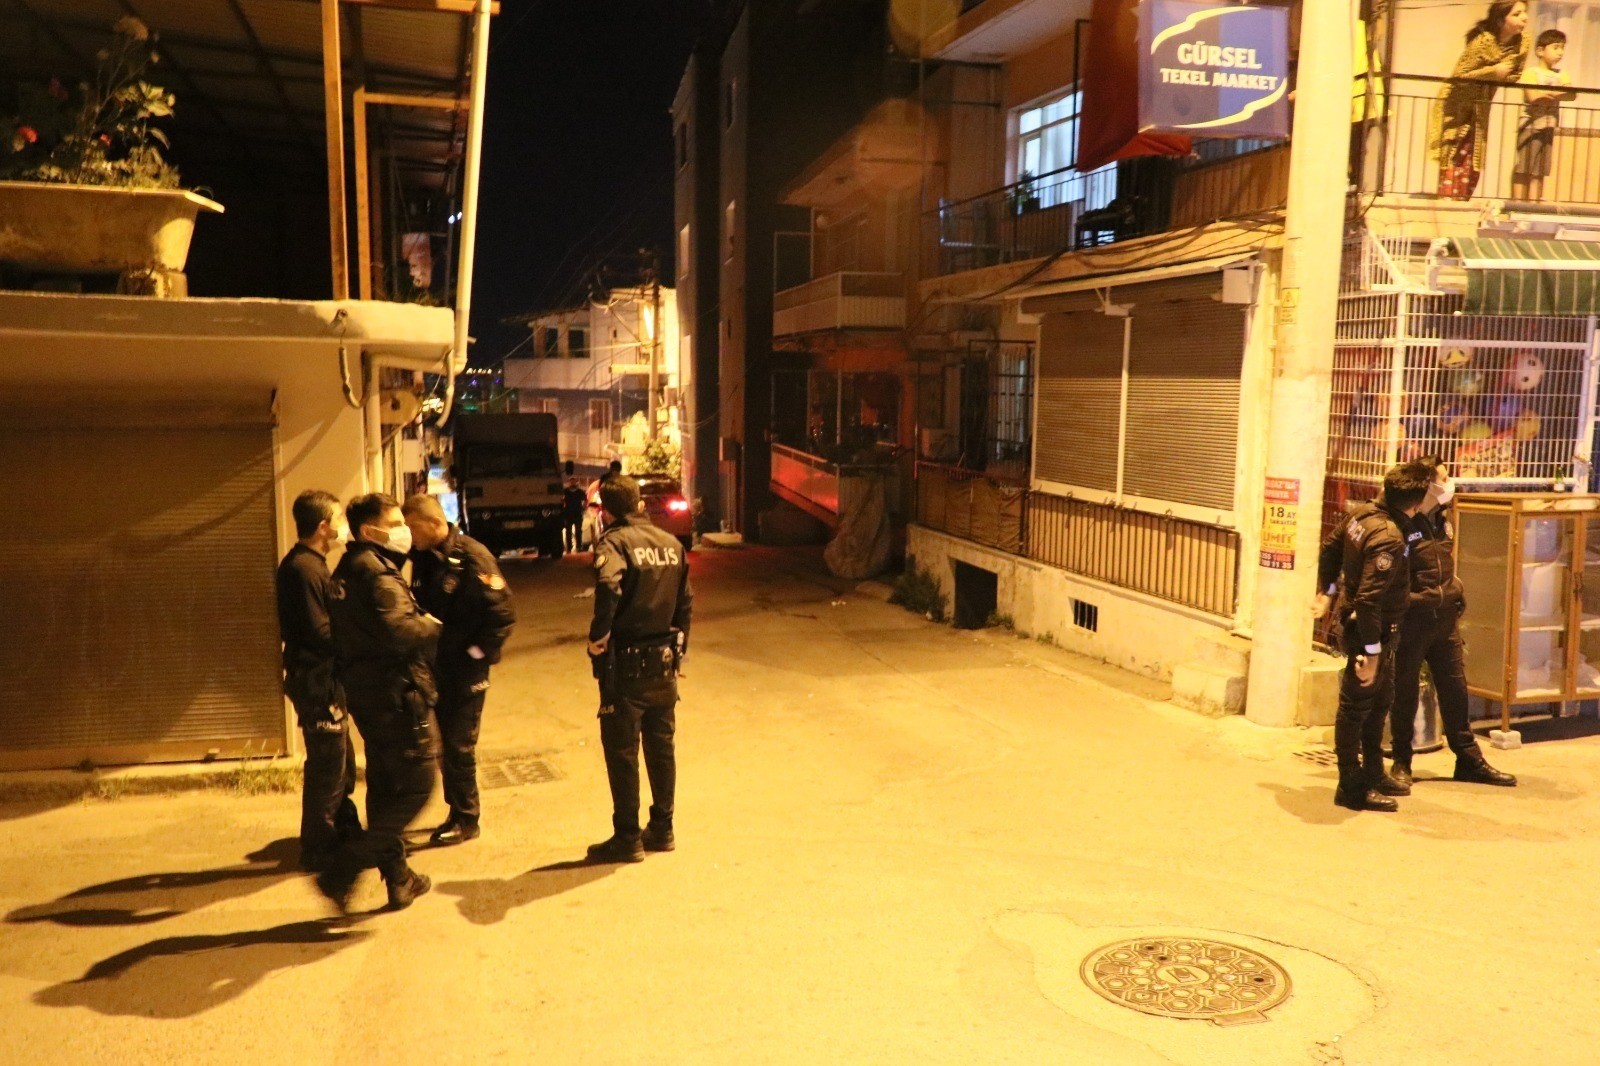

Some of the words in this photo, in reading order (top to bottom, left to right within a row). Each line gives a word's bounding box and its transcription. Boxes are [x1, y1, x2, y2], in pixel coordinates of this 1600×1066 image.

[1177, 41, 1262, 70] GÜRSEL
[1160, 68, 1210, 86] TEKEL
[1212, 72, 1278, 90] MARKET
[1270, 506, 1285, 518] 18
